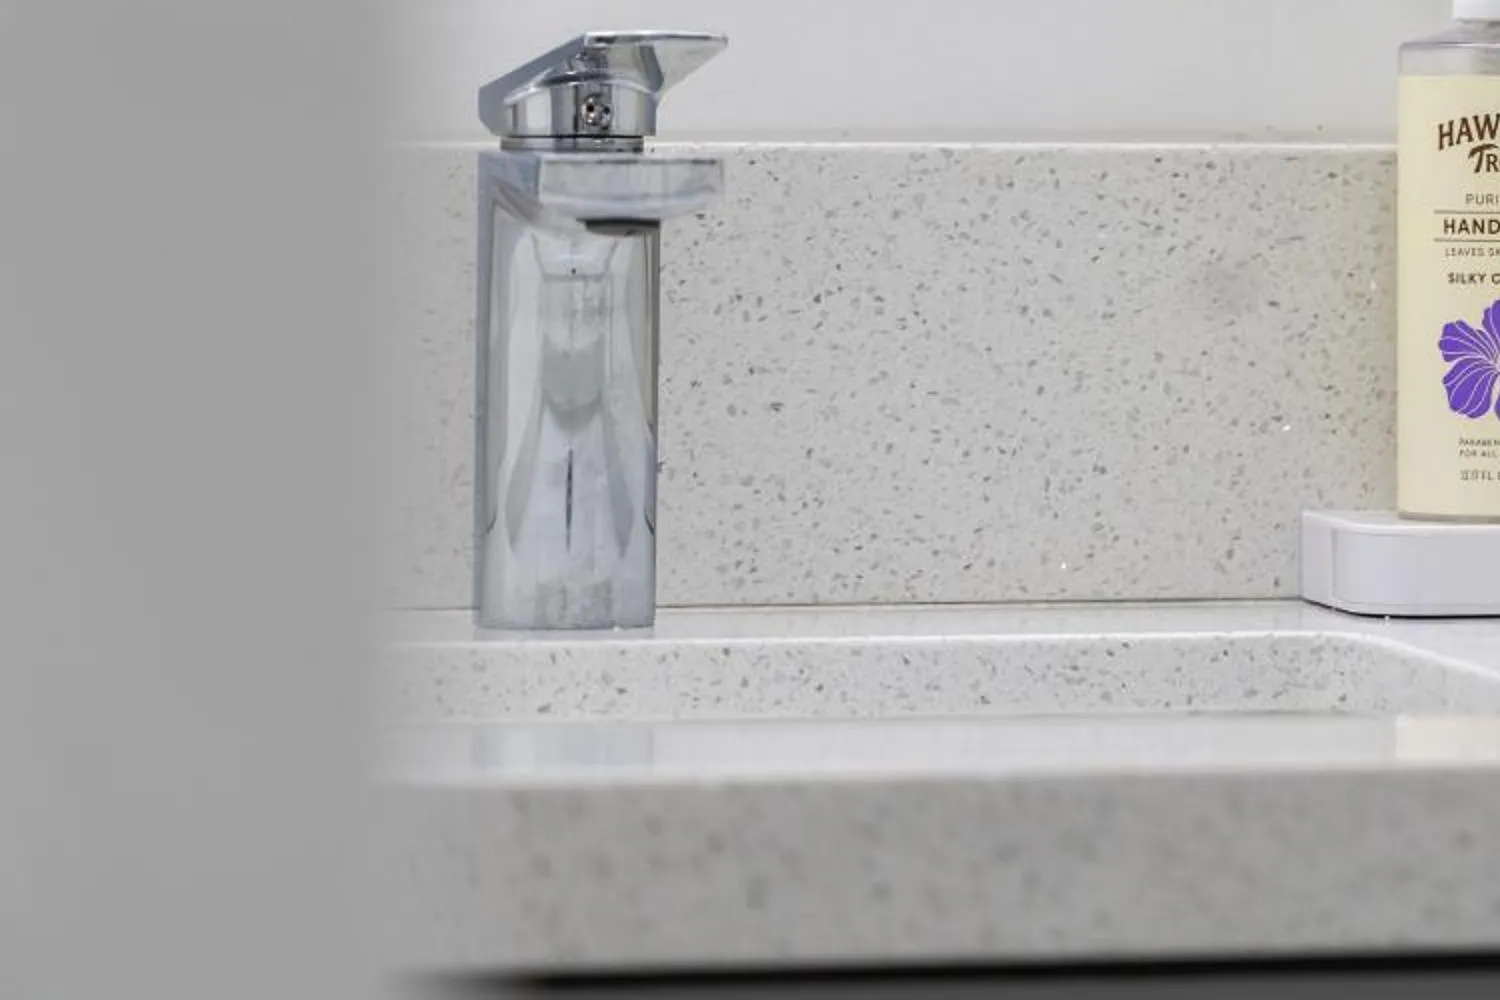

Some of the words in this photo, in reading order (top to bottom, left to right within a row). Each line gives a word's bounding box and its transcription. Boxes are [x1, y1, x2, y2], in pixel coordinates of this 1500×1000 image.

[1443, 218, 1500, 235] HAND
[1444, 247, 1485, 257] LEAVES
[1447, 271, 1486, 285] SILKY
